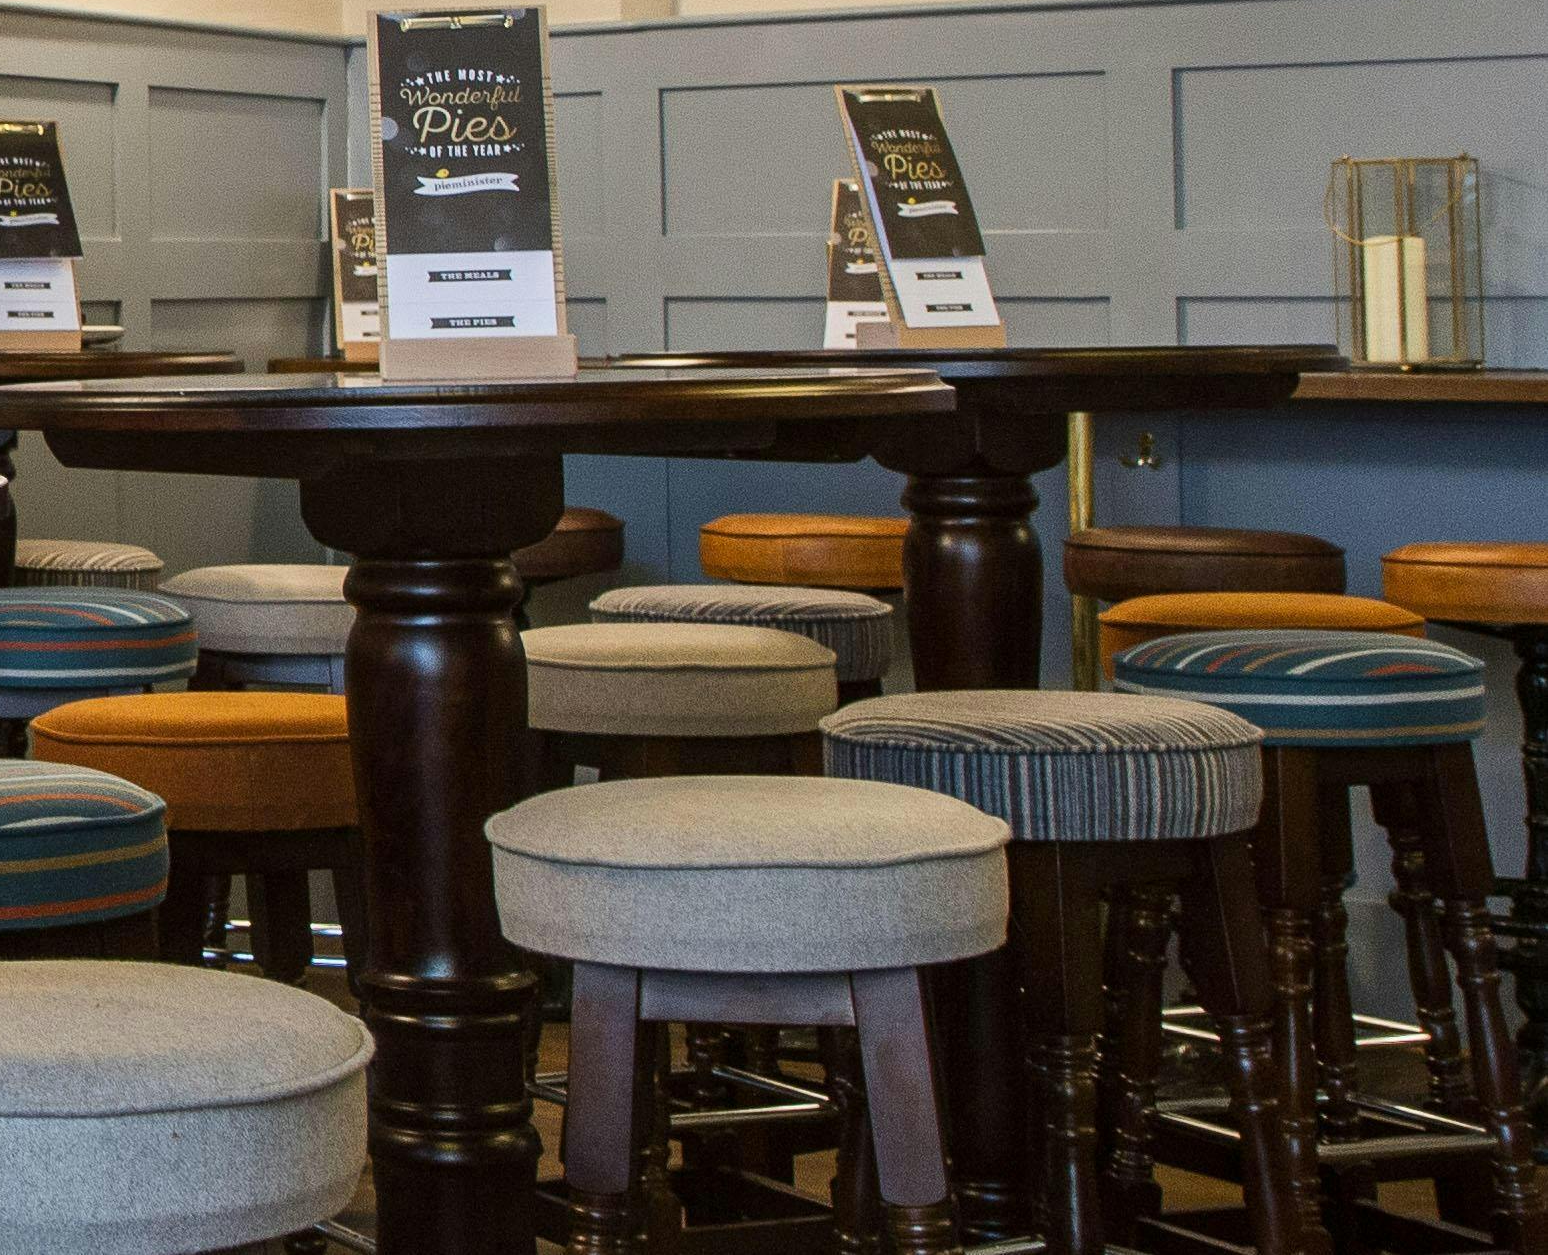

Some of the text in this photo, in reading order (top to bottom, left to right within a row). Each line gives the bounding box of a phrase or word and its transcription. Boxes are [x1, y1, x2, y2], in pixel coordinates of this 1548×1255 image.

[426, 68, 493, 84] THE MOST
[400, 85, 520, 110] Wonderful
[413, 106, 517, 143] Pies
[429, 144, 501, 158] OF THE YEAR
[884, 153, 946, 180] Pies
[434, 177, 503, 191] pieminister
